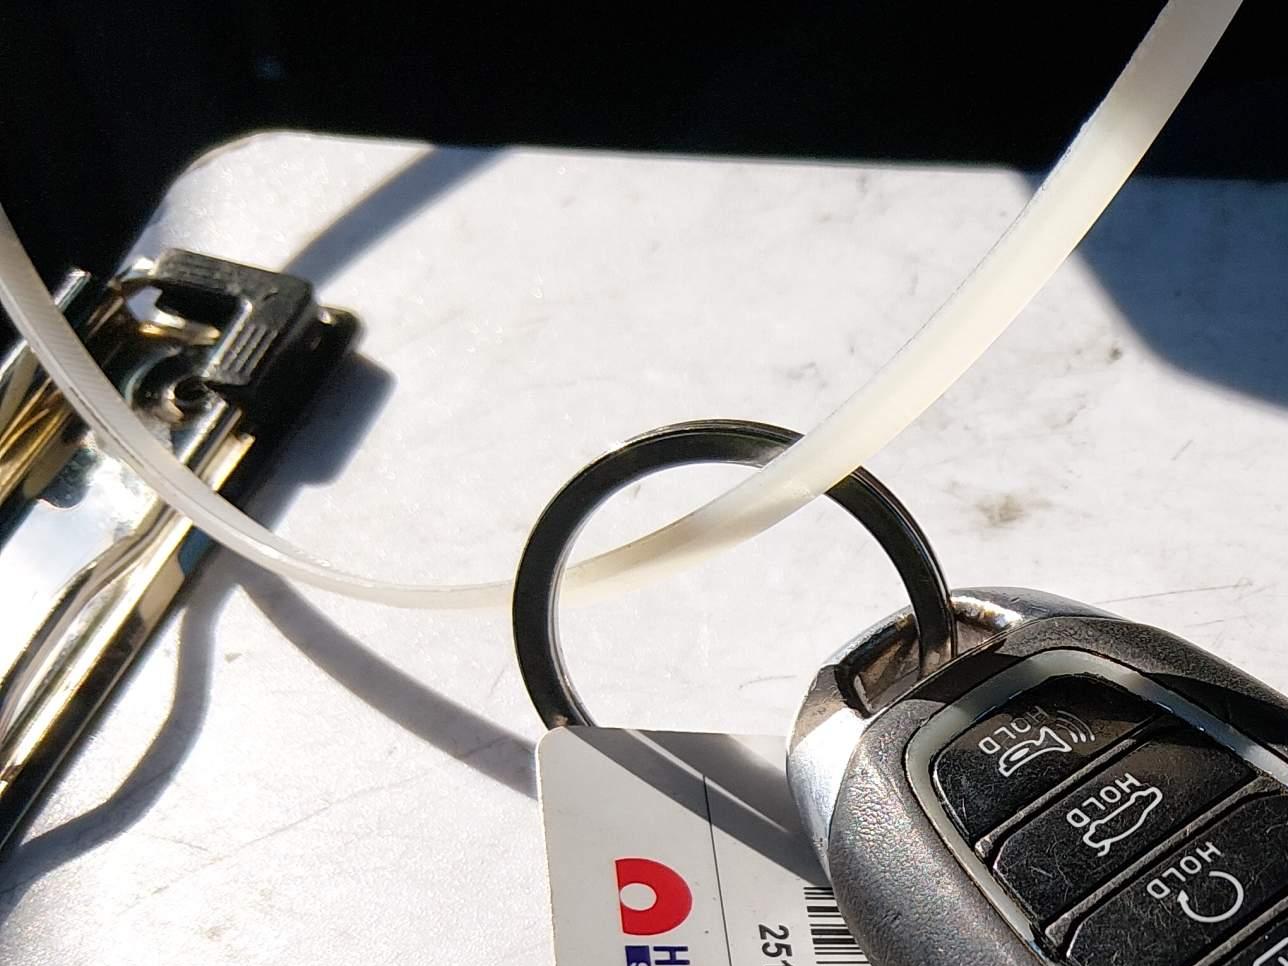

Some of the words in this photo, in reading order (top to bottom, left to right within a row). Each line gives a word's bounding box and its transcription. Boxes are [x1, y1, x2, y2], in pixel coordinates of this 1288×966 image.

[978, 706, 1050, 755] HOLD
[1066, 772, 1142, 828] HOLD
[1146, 841, 1222, 900] HOLD
